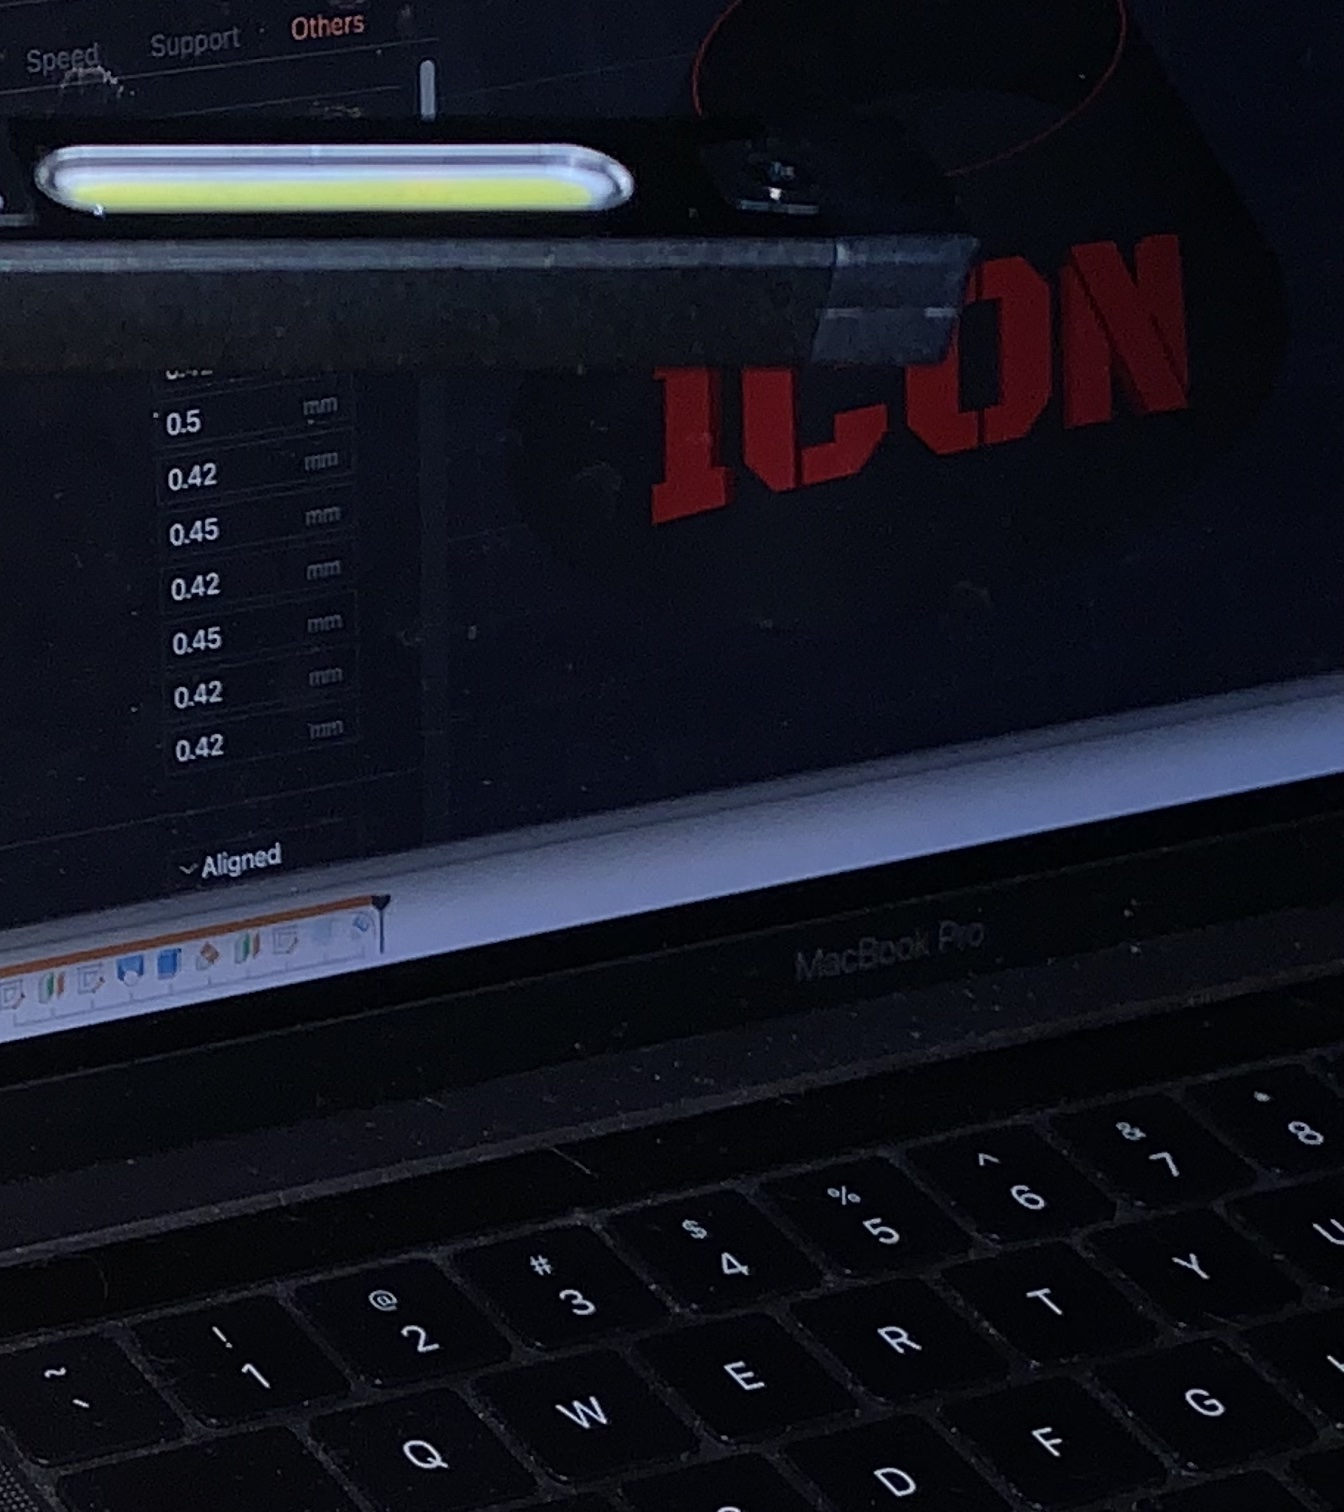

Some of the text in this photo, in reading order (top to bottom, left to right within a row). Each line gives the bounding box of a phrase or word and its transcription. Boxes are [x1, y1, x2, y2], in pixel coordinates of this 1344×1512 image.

[290, 14, 366, 42] Others
[151, 26, 242, 60] Support
[26, 42, 100, 77] Speed
[165, 409, 202, 436] 0.5
[168, 463, 217, 491] 0.42
[169, 517, 219, 547] 0.45
[171, 573, 221, 602] 0.42
[172, 626, 222, 657] 0.45
[173, 681, 223, 709] 0.42
[175, 733, 224, 764] 0.42
[202, 843, 282, 879] Aligned
[794, 919, 987, 983] MacBook Pro
[1288, 1120, 1324, 1147] 8
[1149, 1150, 1180, 1177] 7
[1010, 1184, 1045, 1211] 6
[862, 1216, 900, 1245] 5
[529, 1254, 554, 1276] #
[720, 1251, 750, 1278] 4
[1172, 1252, 1210, 1281] Y
[368, 1289, 398, 1312] @
[558, 1289, 597, 1317] 3
[1026, 1287, 1063, 1316] T
[401, 1325, 440, 1354] 2
[877, 1324, 922, 1355] R
[241, 1363, 271, 1389] 1
[724, 1360, 766, 1393] E
[555, 1395, 609, 1429] W
[1184, 1388, 1225, 1418] G
[402, 1440, 449, 1471] Q
[1031, 1426, 1063, 1458] F
[873, 1466, 916, 1497] D
